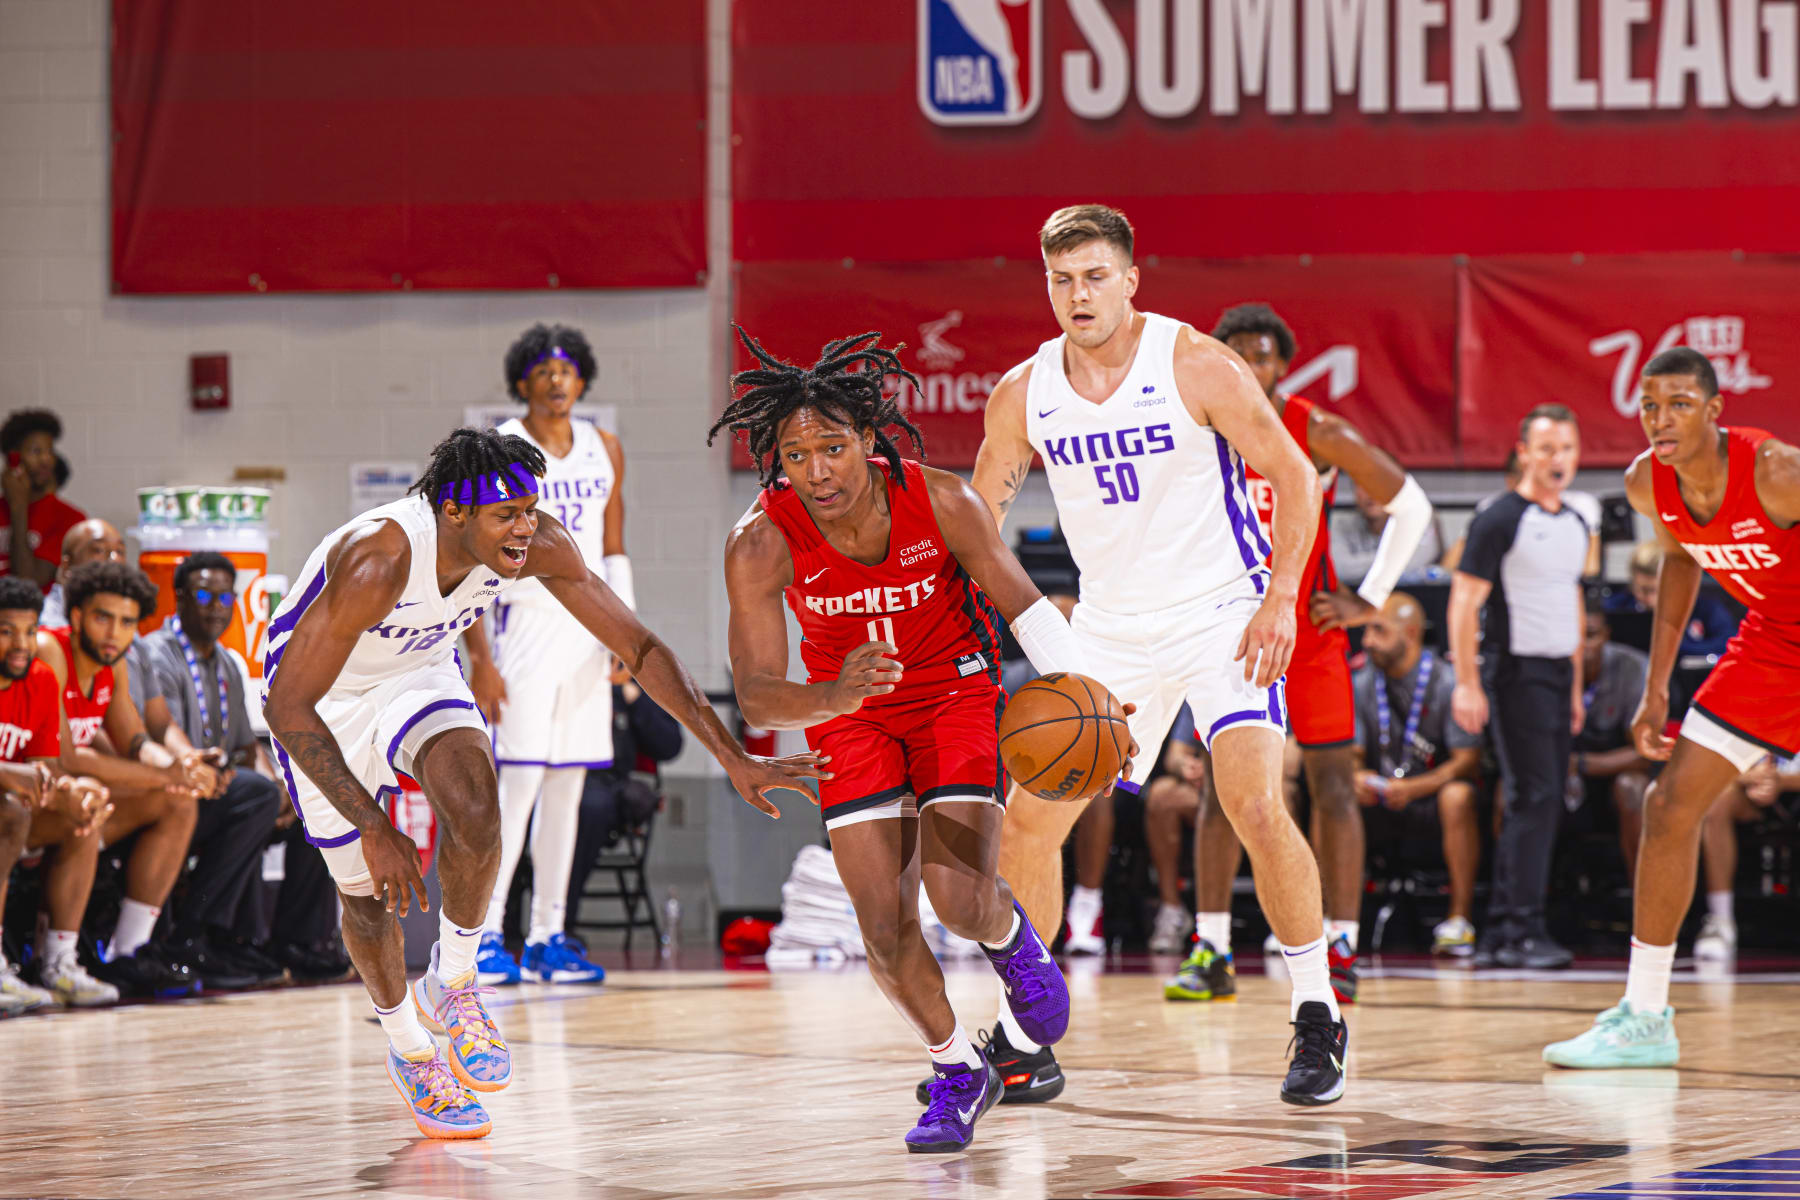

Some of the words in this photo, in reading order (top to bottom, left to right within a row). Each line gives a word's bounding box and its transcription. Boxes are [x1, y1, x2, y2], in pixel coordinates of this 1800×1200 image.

[1062, 0, 1521, 118] SUMMER
[934, 55, 995, 105] NBA
[1133, 397, 1166, 408] dialpad
[1044, 423, 1175, 466] KINGS
[543, 478, 607, 500] INGS
[1093, 462, 1140, 505] 50
[900, 539, 934, 556] credit
[900, 548, 939, 567] karma
[805, 574, 937, 617] ROCKETS
[396, 631, 448, 656] 18
